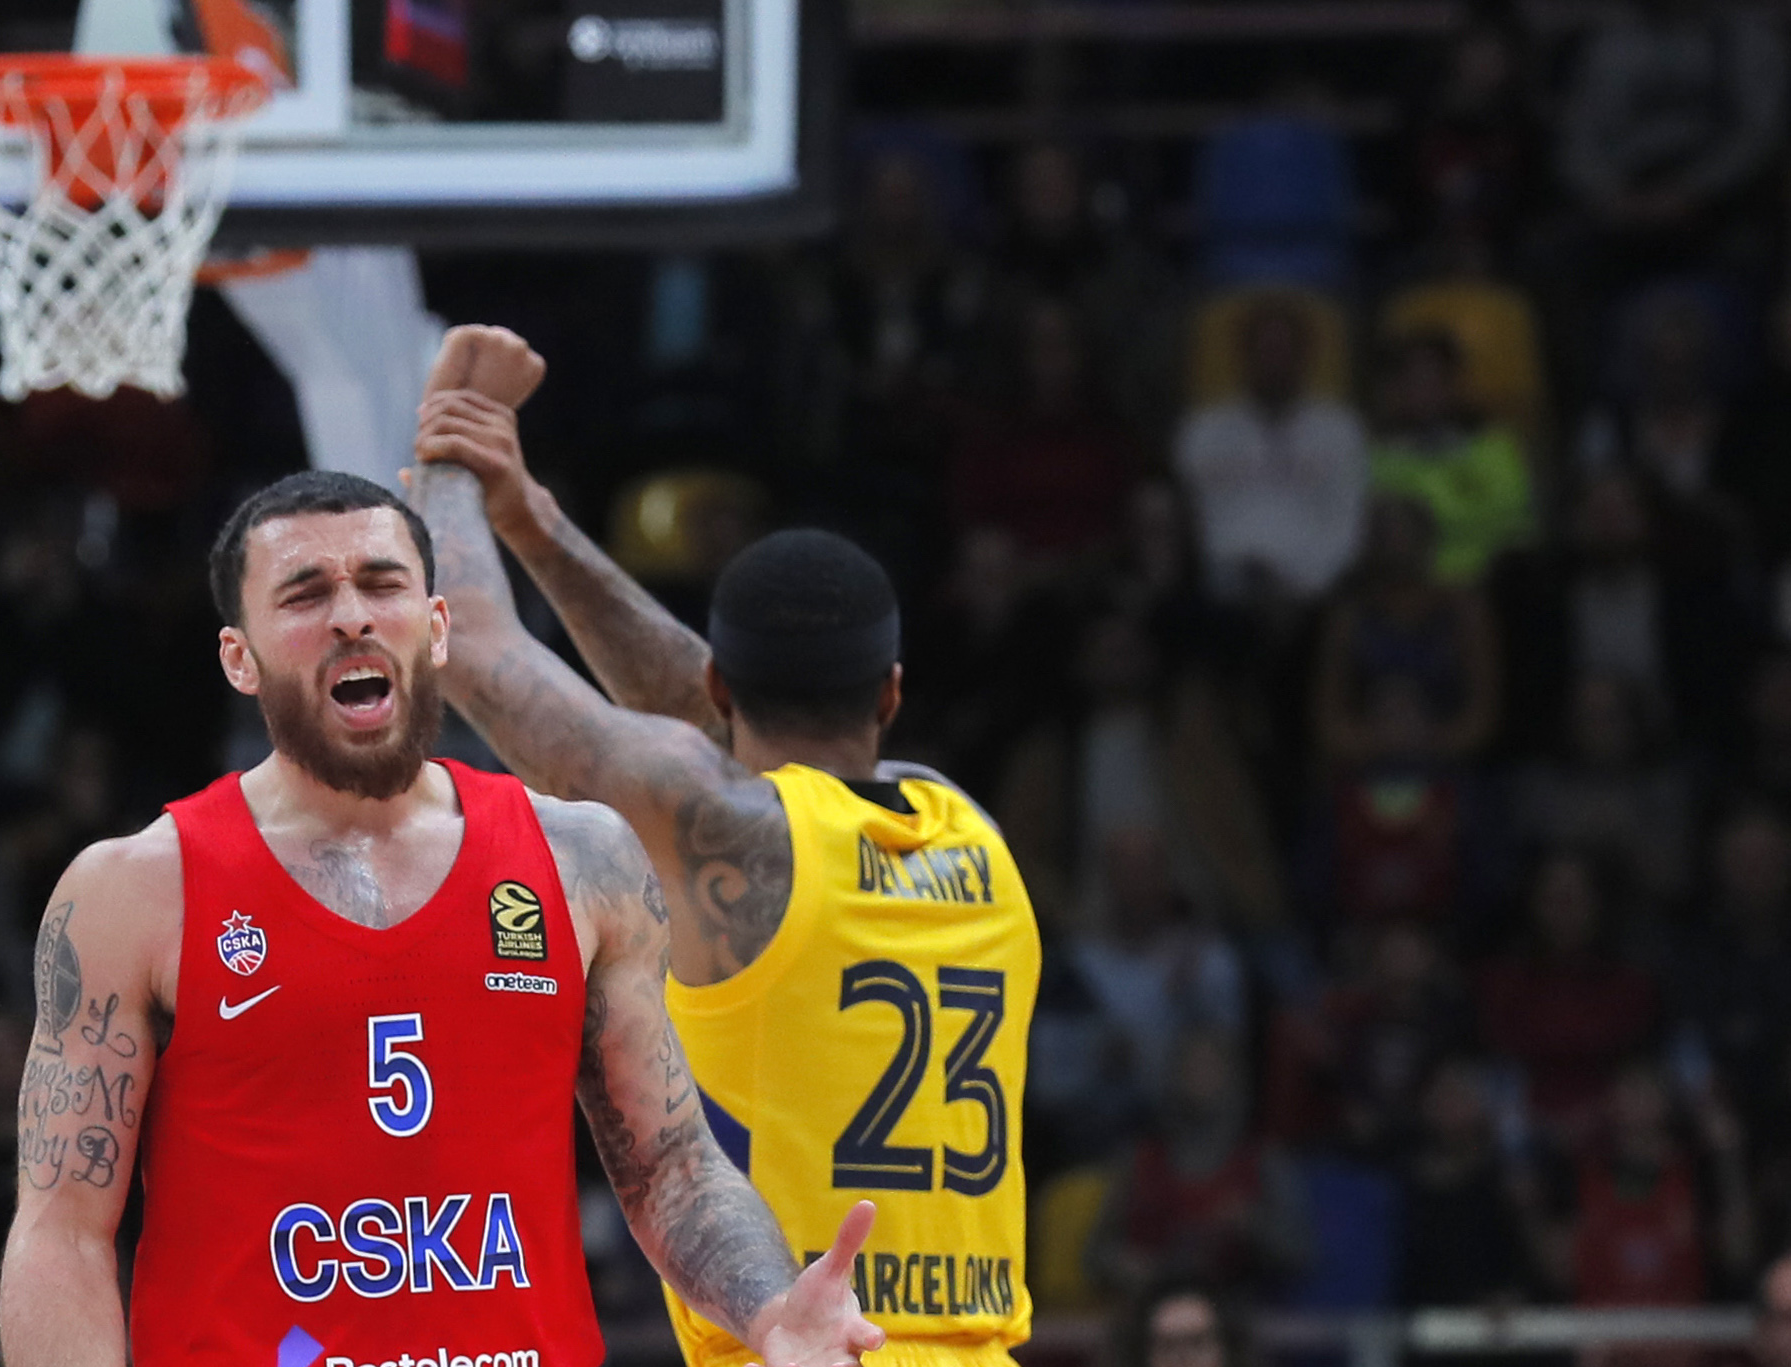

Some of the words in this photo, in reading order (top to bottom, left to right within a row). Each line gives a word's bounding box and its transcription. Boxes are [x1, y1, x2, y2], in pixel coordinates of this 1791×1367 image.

[859, 831, 993, 903] DELANEY
[223, 934, 261, 952] CSKA
[497, 931, 542, 941] TURKISH
[498, 940, 543, 949] AIRLINES
[367, 1013, 434, 1137] 5
[833, 959, 1006, 1196] 23
[270, 1194, 531, 1302] CSKA
[805, 1251, 1013, 1316] ARCELONA
